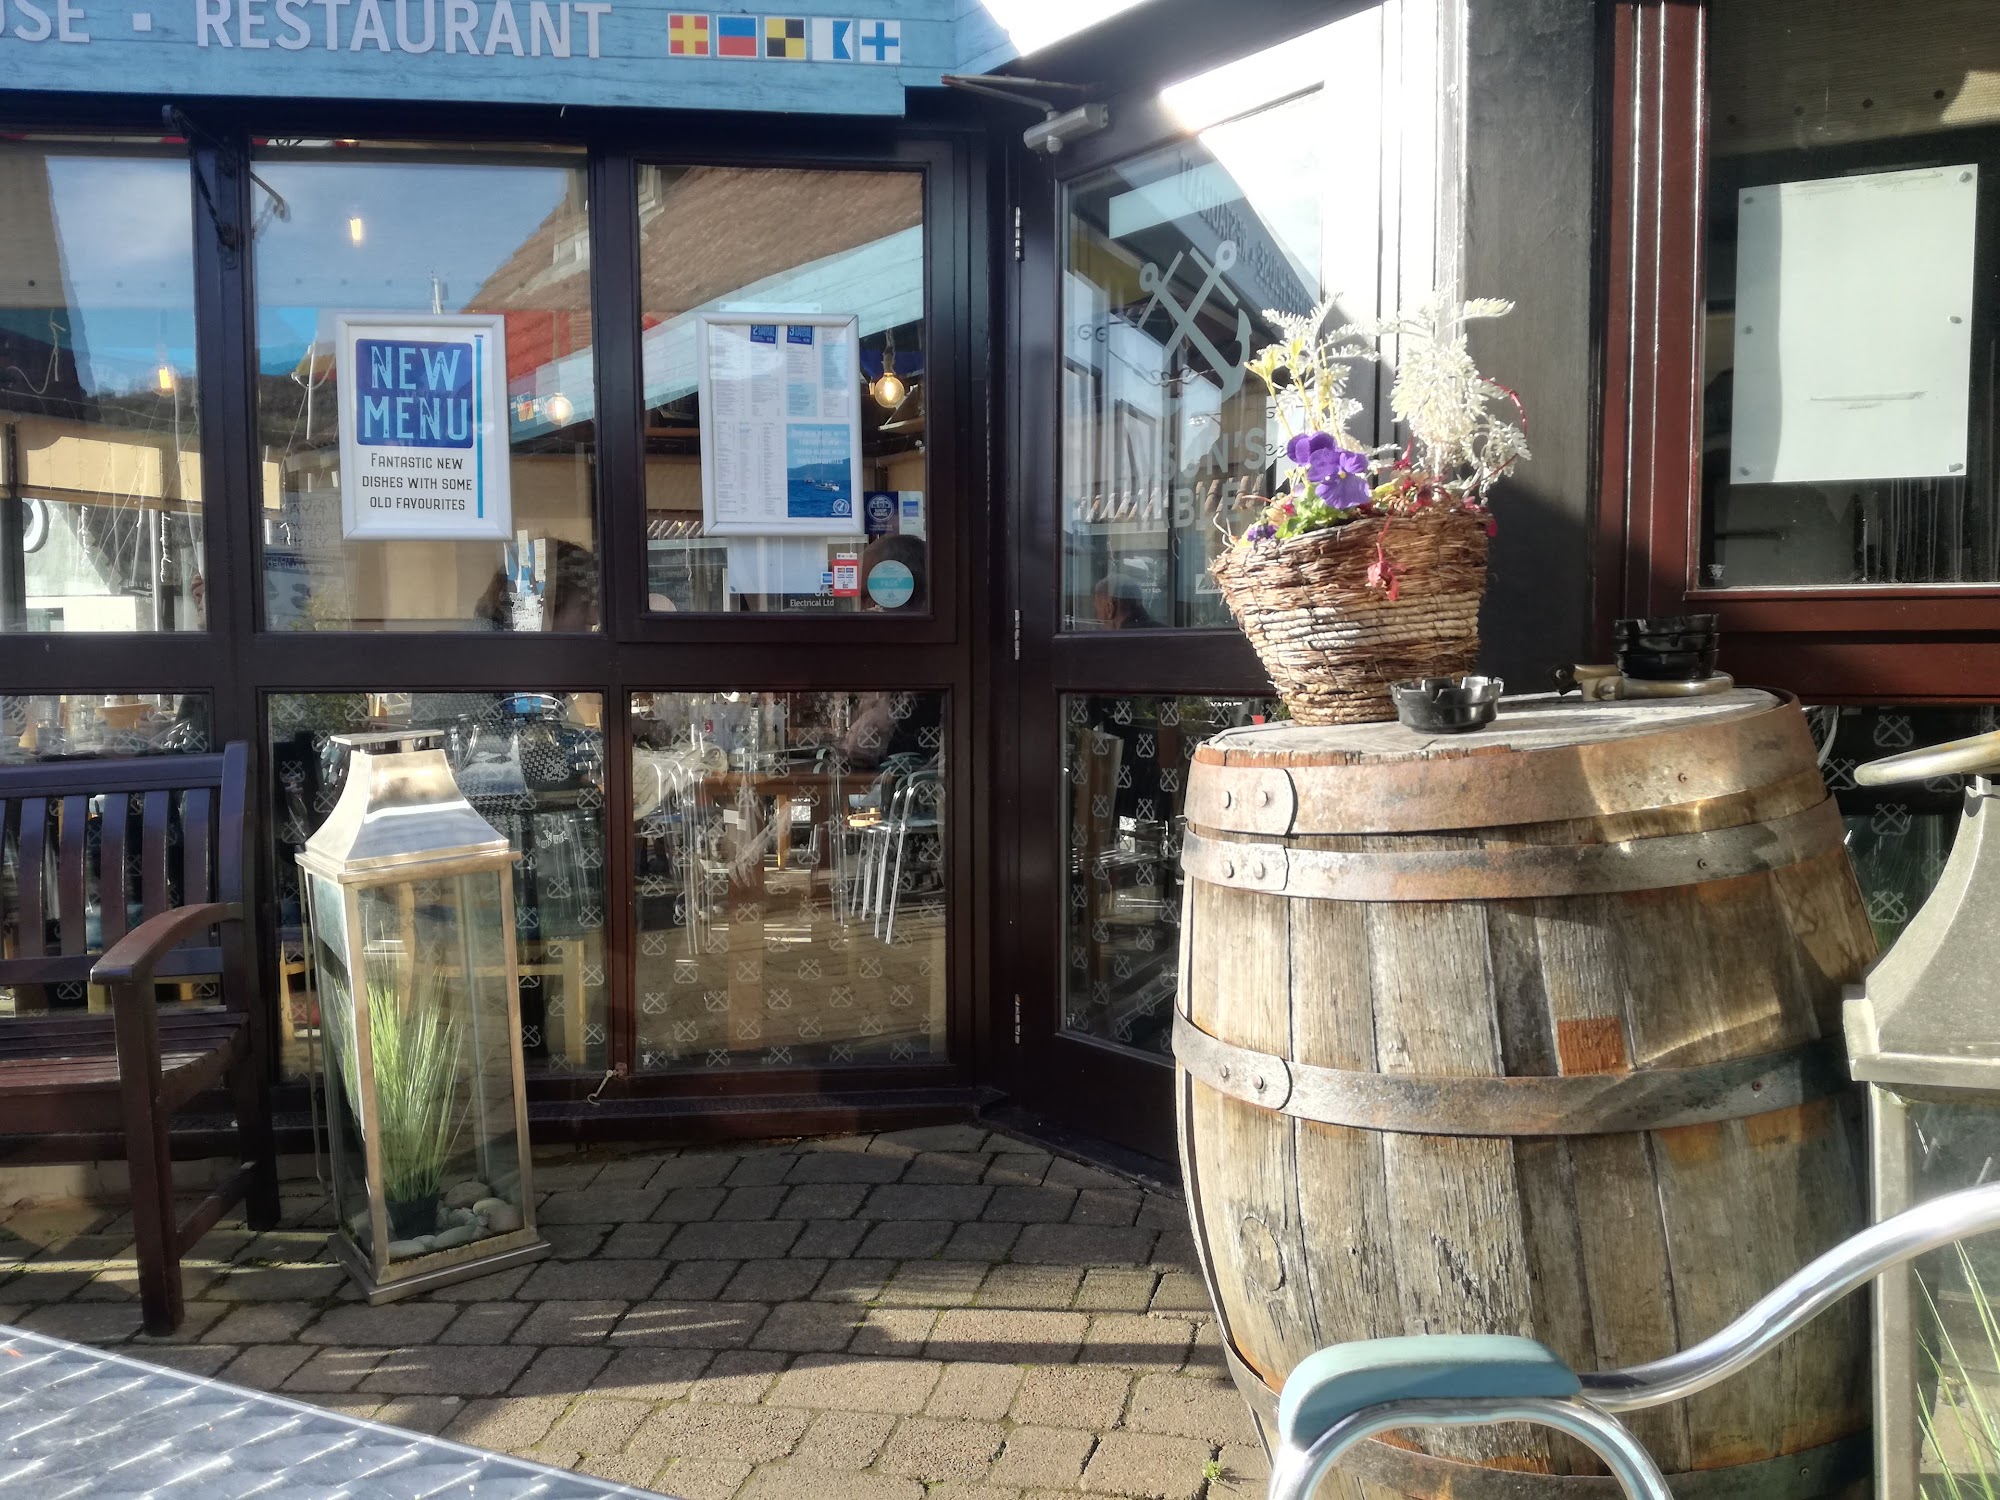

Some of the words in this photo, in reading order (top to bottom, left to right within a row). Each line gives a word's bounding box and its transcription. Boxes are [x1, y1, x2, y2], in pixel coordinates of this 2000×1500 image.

[197, 0, 612, 58] RESTAURANT
[370, 346, 461, 391] NEW
[364, 395, 468, 441] MENU
[371, 453, 433, 469] FANTASTIC
[437, 458, 463, 470] NEW
[362, 475, 403, 488] DISHES
[408, 477, 437, 490] WITH
[442, 478, 472, 491] SOME
[370, 496, 392, 508] OLD
[396, 497, 465, 511] FAVOURITES
[790, 598, 821, 607] Electrical
[823, 598, 834, 607] Ltd
